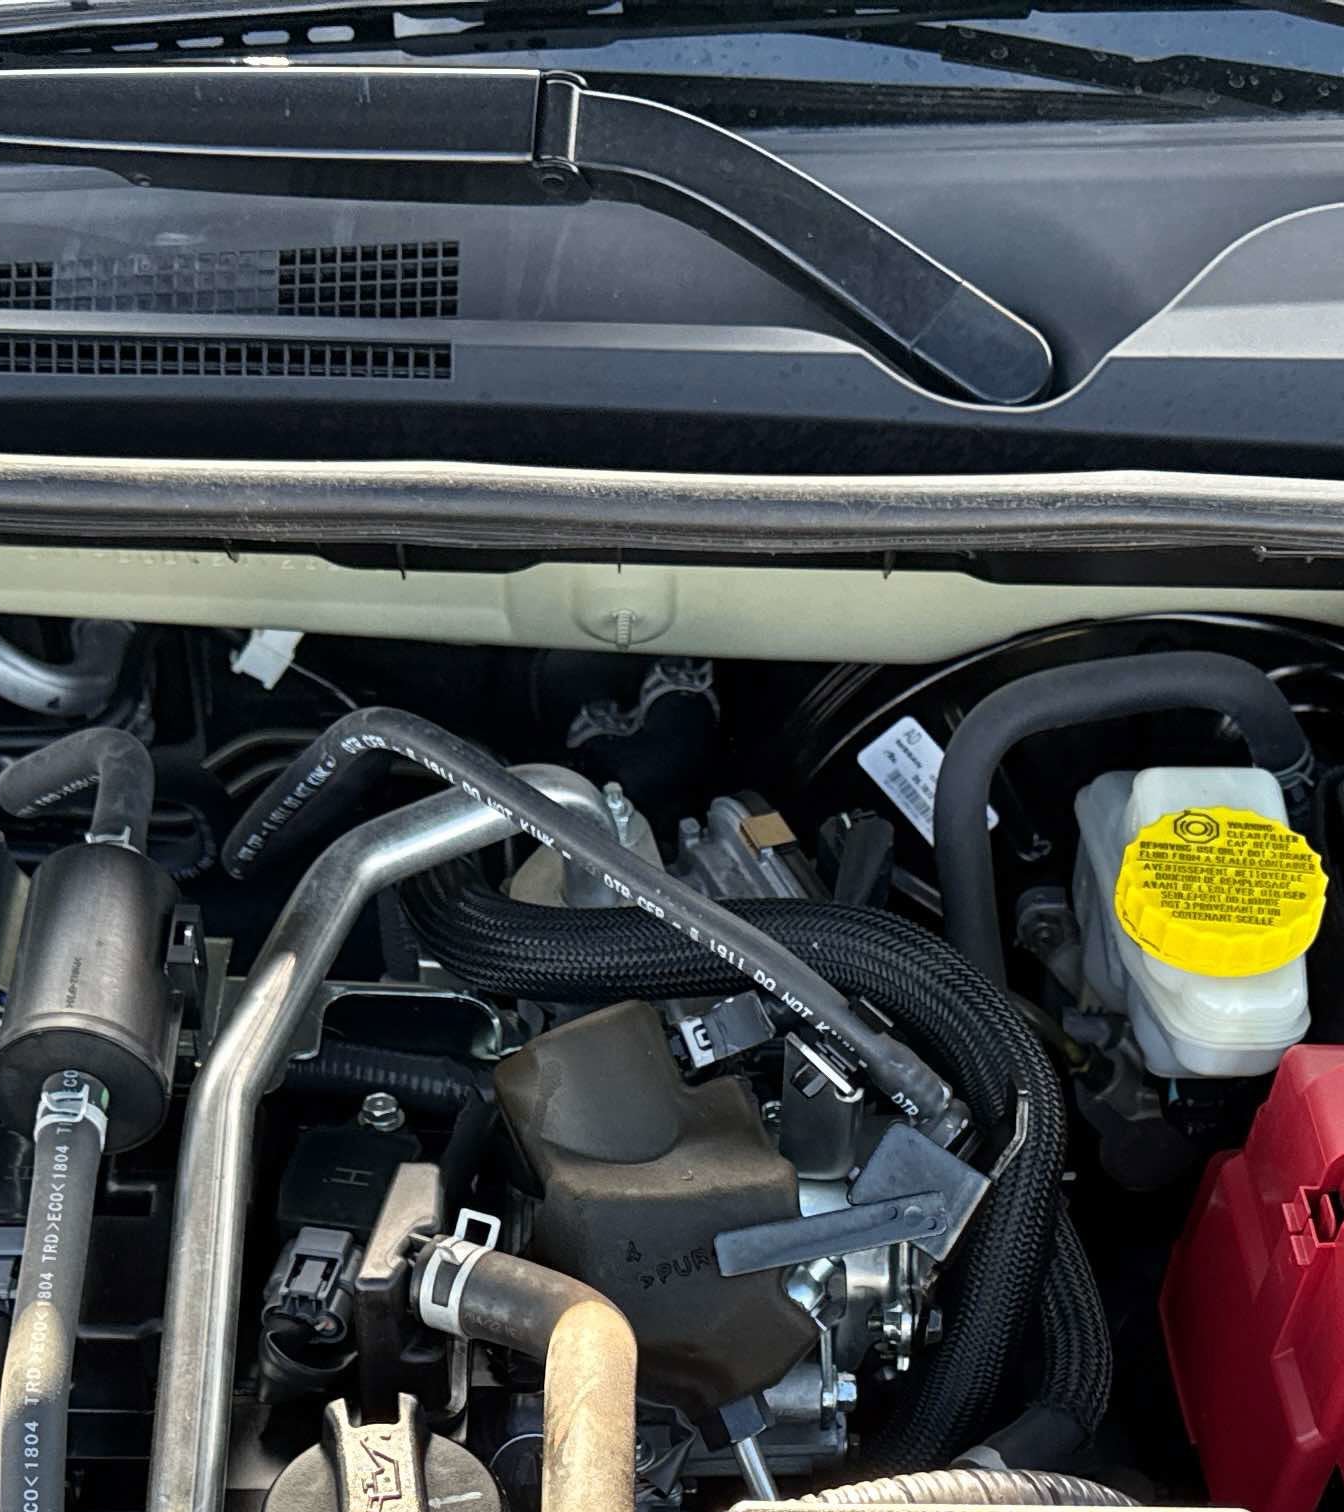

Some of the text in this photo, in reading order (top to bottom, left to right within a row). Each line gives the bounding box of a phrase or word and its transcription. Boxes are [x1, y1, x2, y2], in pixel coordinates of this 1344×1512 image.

[462, 780, 482, 801] DO
[710, 939, 745, 970] 1911
[753, 969, 777, 992] DO
[781, 992, 814, 1018] NOT
[41, 1144, 71, 1263] TRD>ECO<1804
